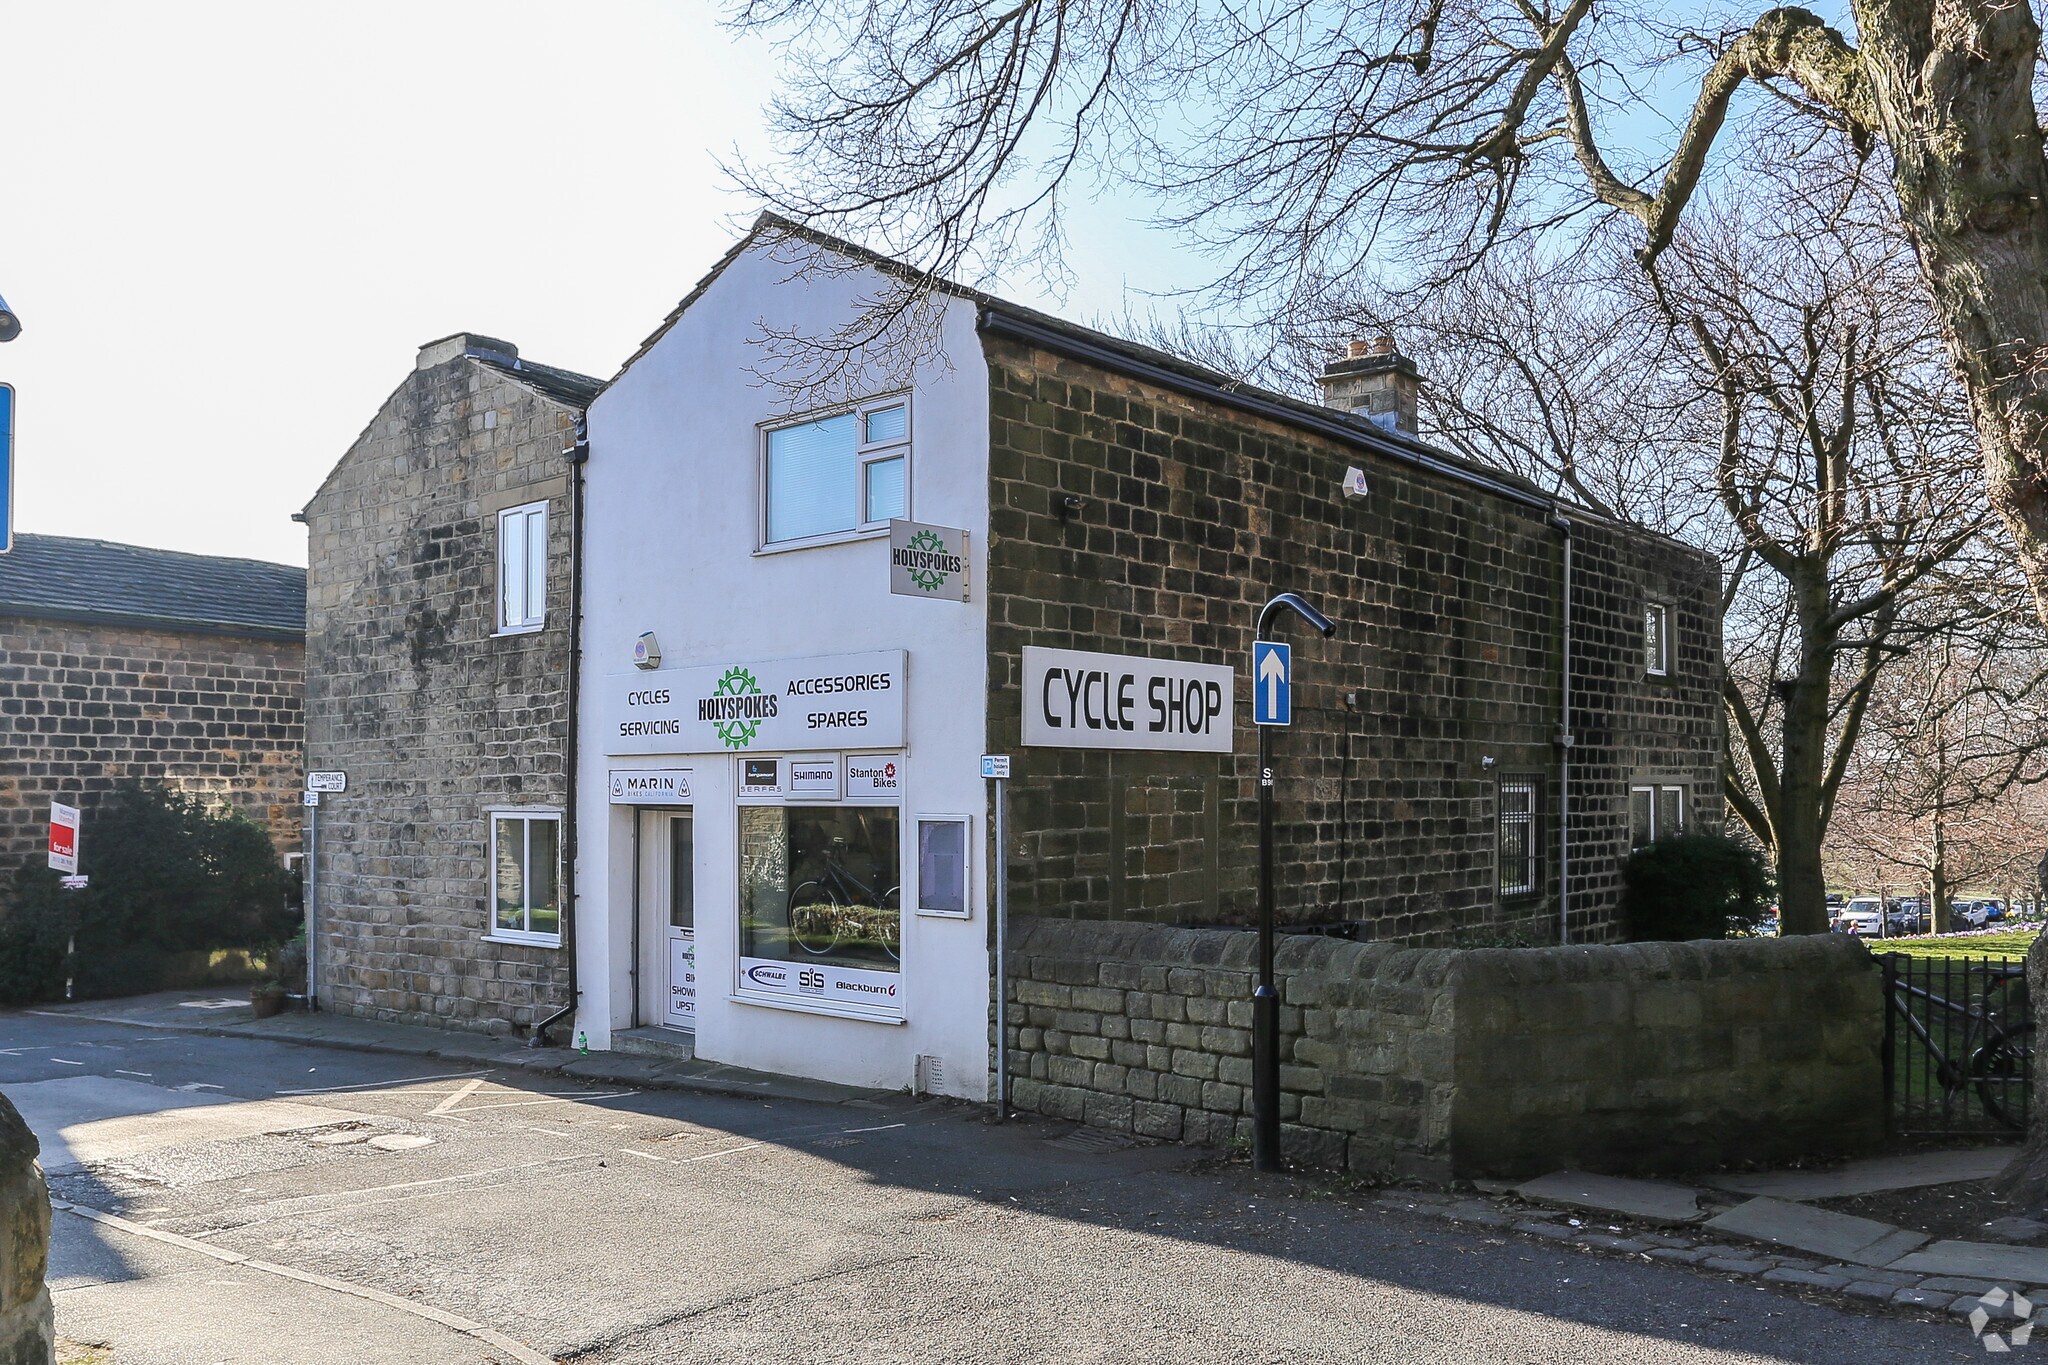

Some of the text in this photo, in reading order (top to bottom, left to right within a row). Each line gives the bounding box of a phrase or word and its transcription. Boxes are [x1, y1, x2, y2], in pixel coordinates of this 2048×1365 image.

[893, 548, 961, 573] HOLYSPOKES
[787, 673, 891, 696] ACCESSORIES
[628, 689, 670, 706] CYCLES
[1043, 667, 1222, 734] CYCLE SHOP
[699, 694, 778, 721] HOLYSPOKES
[807, 710, 868, 729] SPARES
[620, 720, 680, 736] SERVICING
[794, 770, 833, 780] SHIMANO
[850, 768, 884, 778] Stanton
[1263, 767, 1274, 779] S
[627, 778, 674, 790] MARIN
[873, 777, 897, 788] Bikes
[53, 841, 73, 856] for sale
[754, 970, 787, 981] SCHWALBE
[672, 985, 696, 998] SHOW
[836, 981, 887, 995] Blackburn
[675, 1000, 696, 1012] UPST
